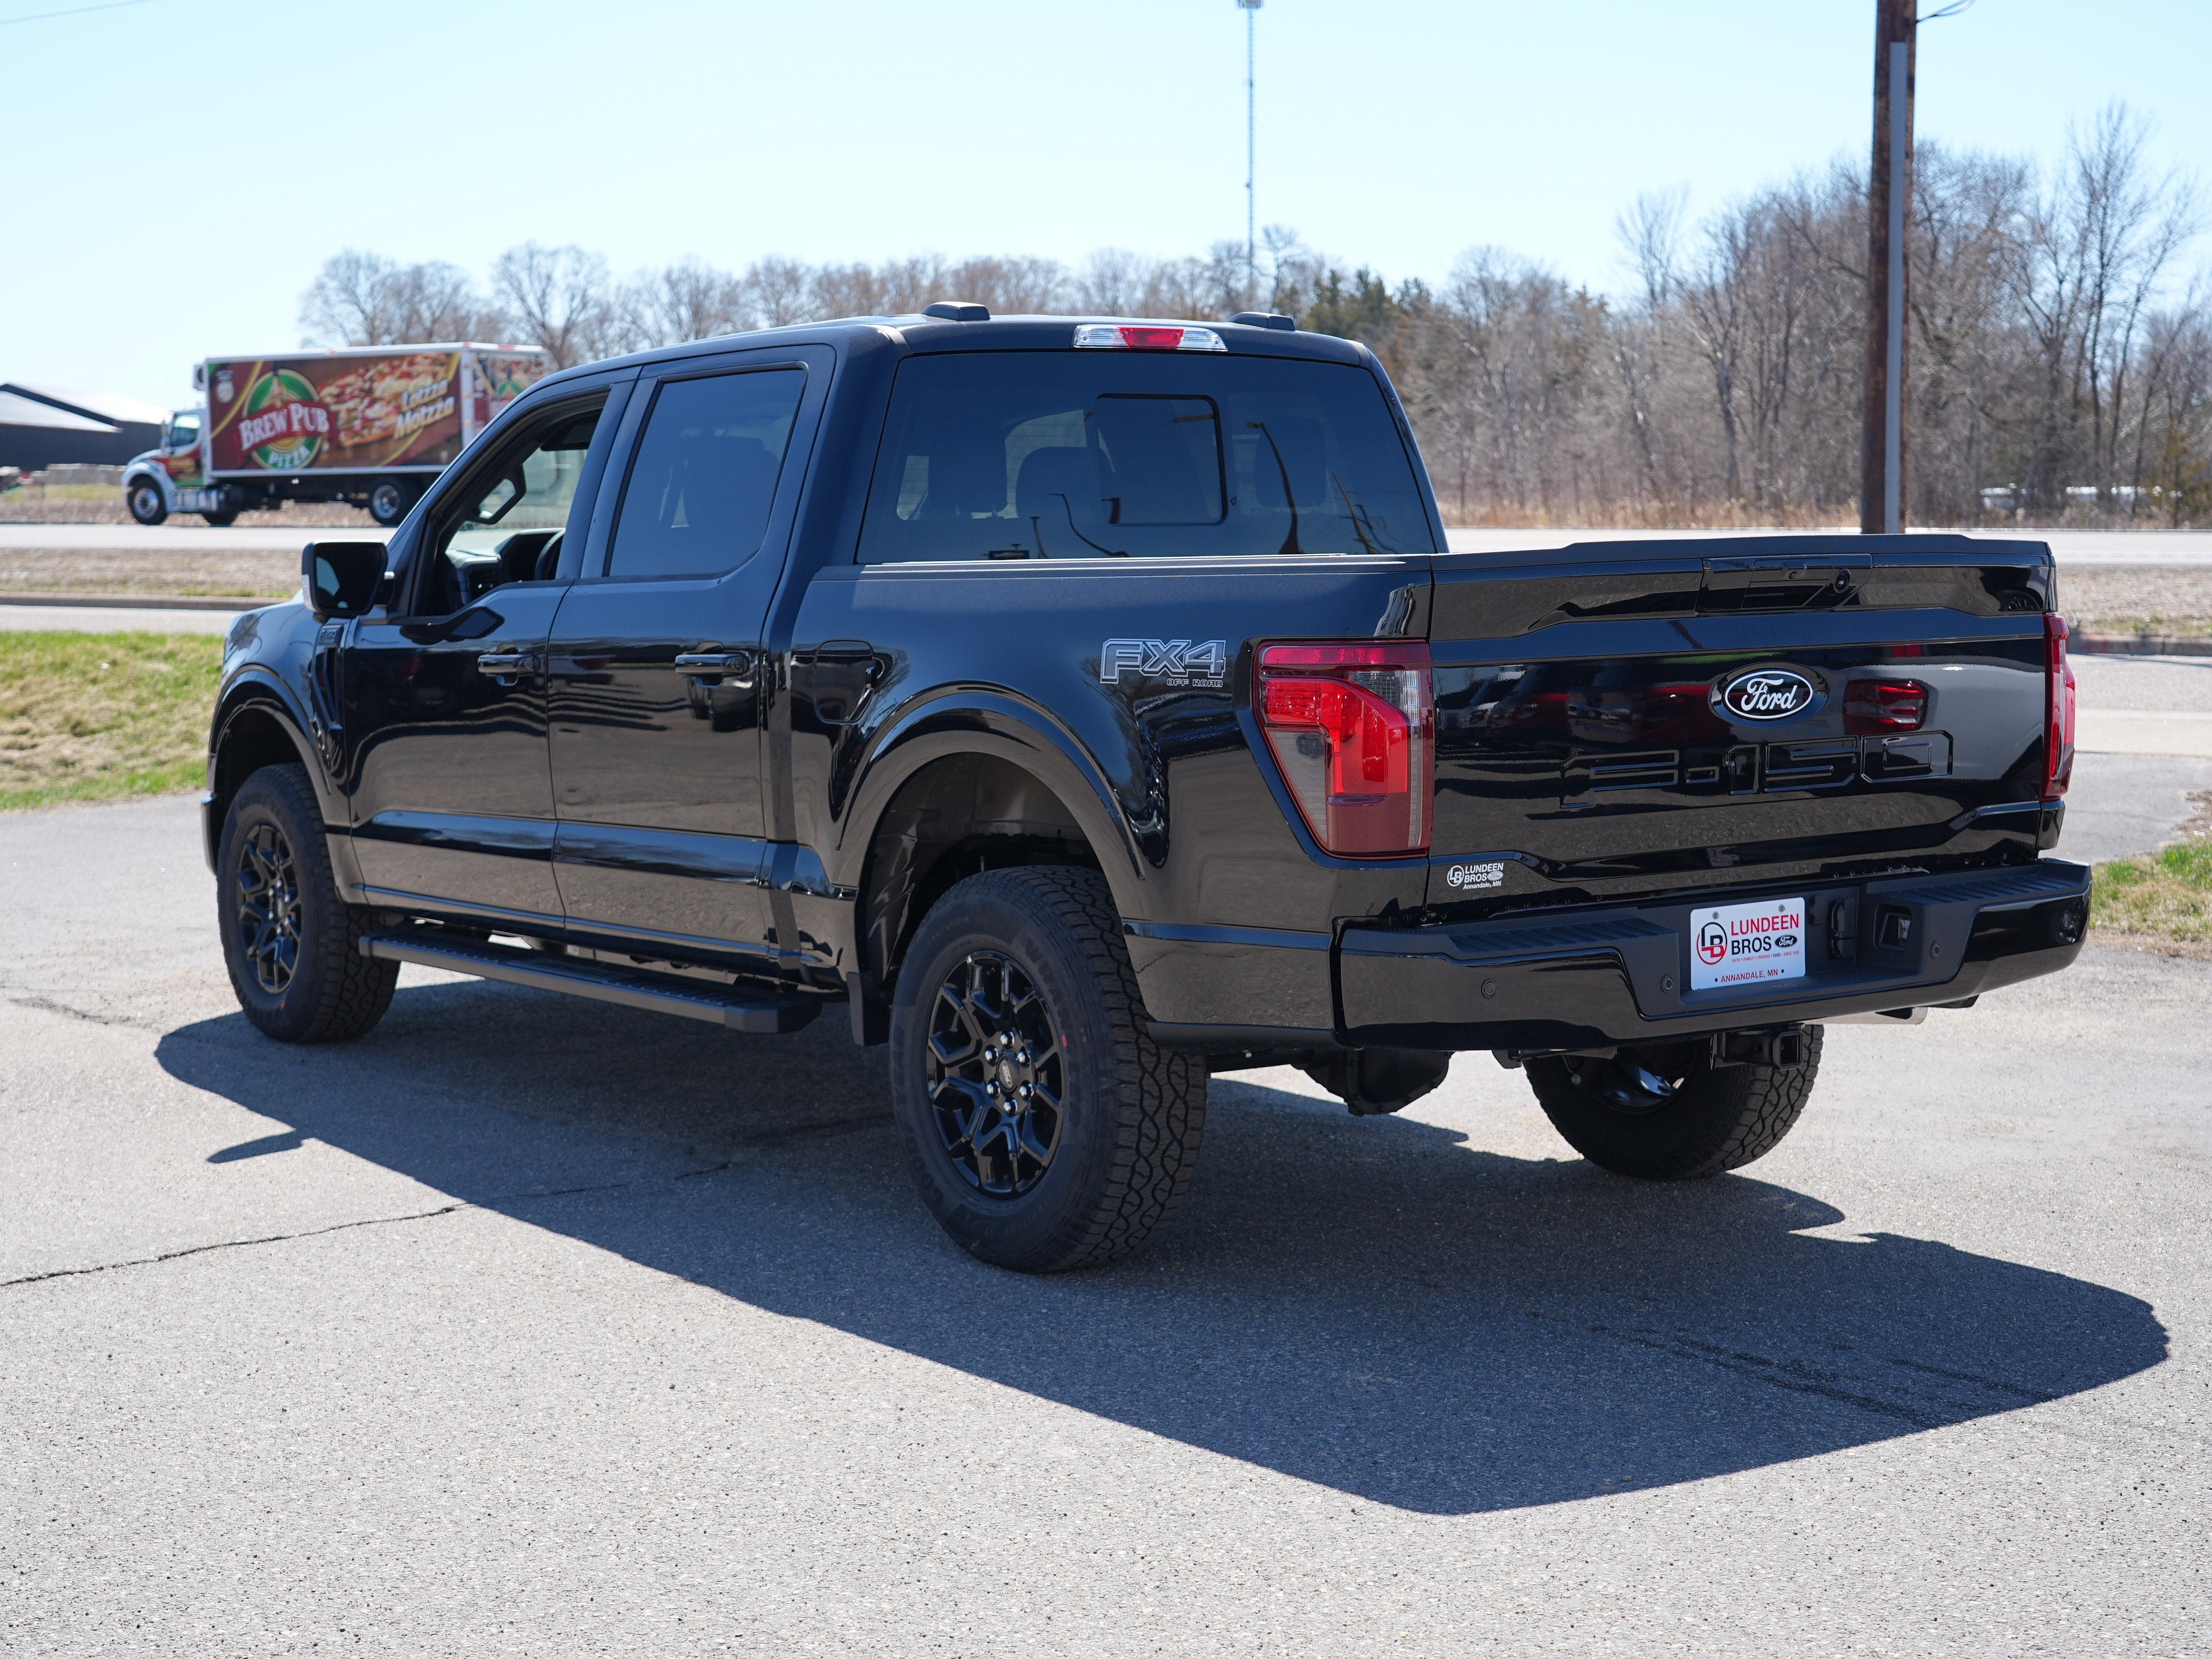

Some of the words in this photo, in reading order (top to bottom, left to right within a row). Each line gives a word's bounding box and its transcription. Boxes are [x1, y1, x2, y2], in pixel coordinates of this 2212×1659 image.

[239, 408, 288, 450] BREW
[288, 402, 329, 433] PUB
[268, 445, 311, 468] PIZZA
[1100, 638, 1226, 684] FX4
[1166, 678, 1189, 686] OFF
[1192, 679, 1223, 687] ROAD
[1740, 678, 1799, 711] Ford
[1465, 862, 1504, 874] LUNDEEN
[1463, 881, 1492, 890] Annandale,
[1464, 873, 1487, 883] BROS
[1731, 913, 1799, 936] LUNDEEN
[1731, 936, 1772, 955] BROS
[1721, 970, 1765, 983] ANNANDALE,
[1767, 968, 1778, 978] MN
